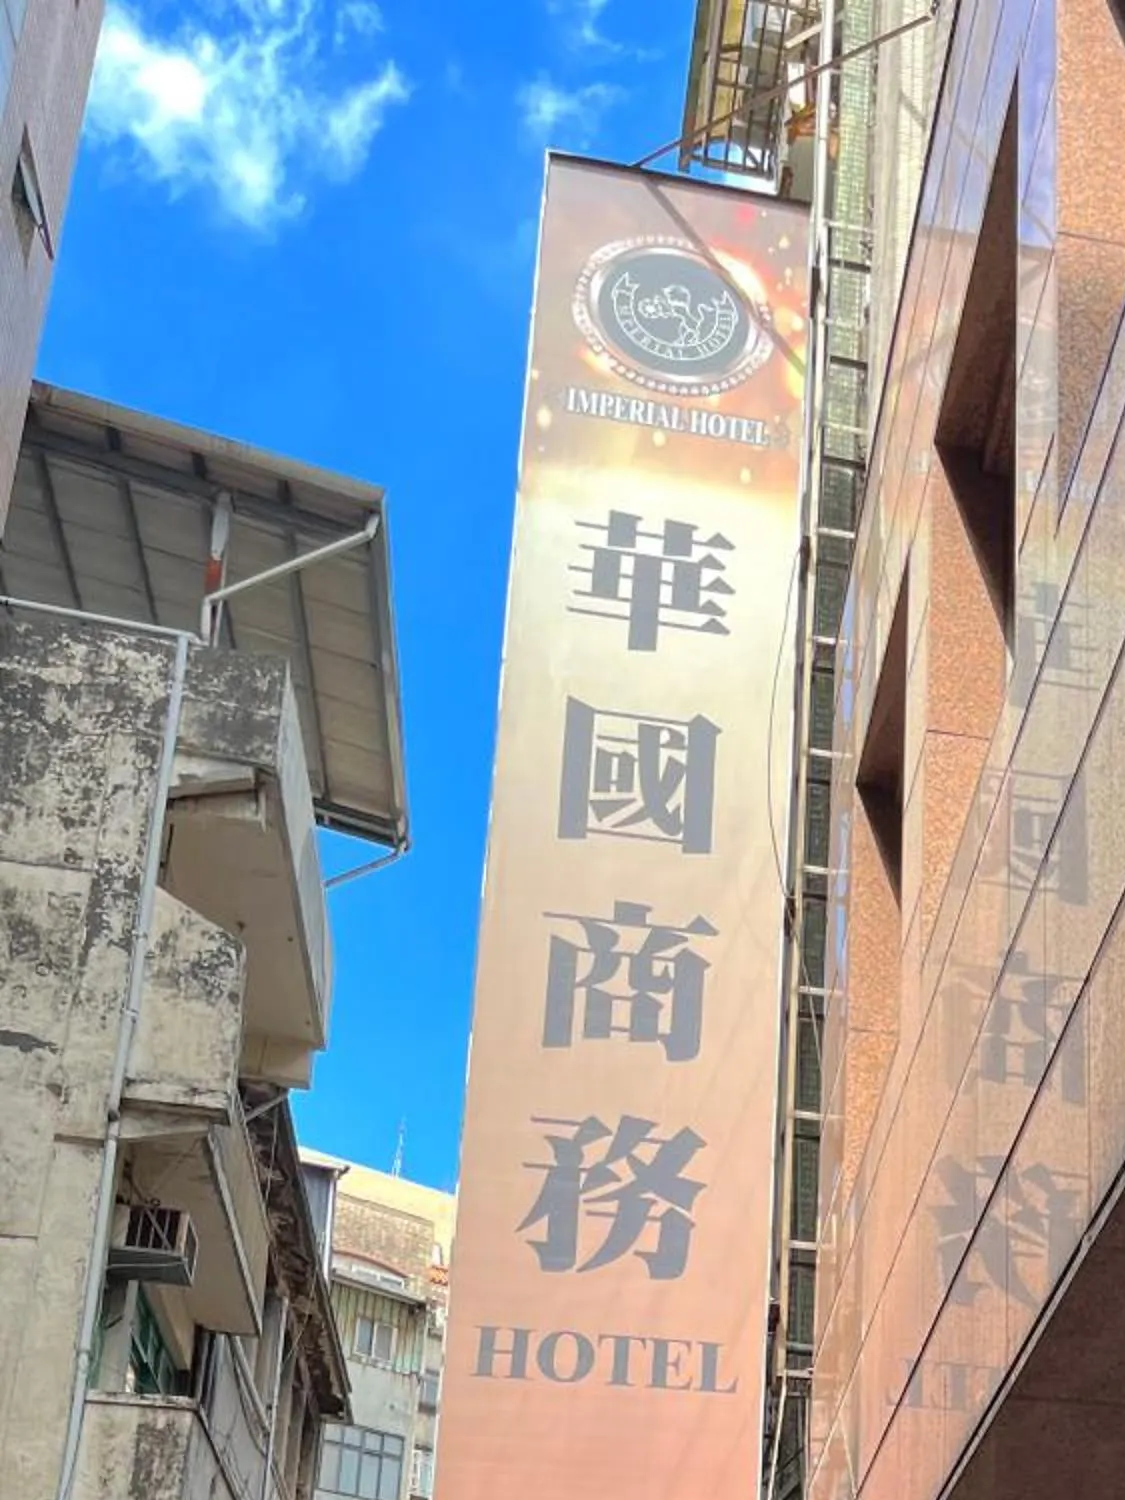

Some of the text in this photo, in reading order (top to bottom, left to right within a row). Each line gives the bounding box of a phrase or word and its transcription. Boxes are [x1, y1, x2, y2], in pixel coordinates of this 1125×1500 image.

[566, 387, 769, 446] IMPERIAL HOTEL
[515, 509, 736, 1280] 華國商務
[470, 1325, 739, 1395] HOTEL
